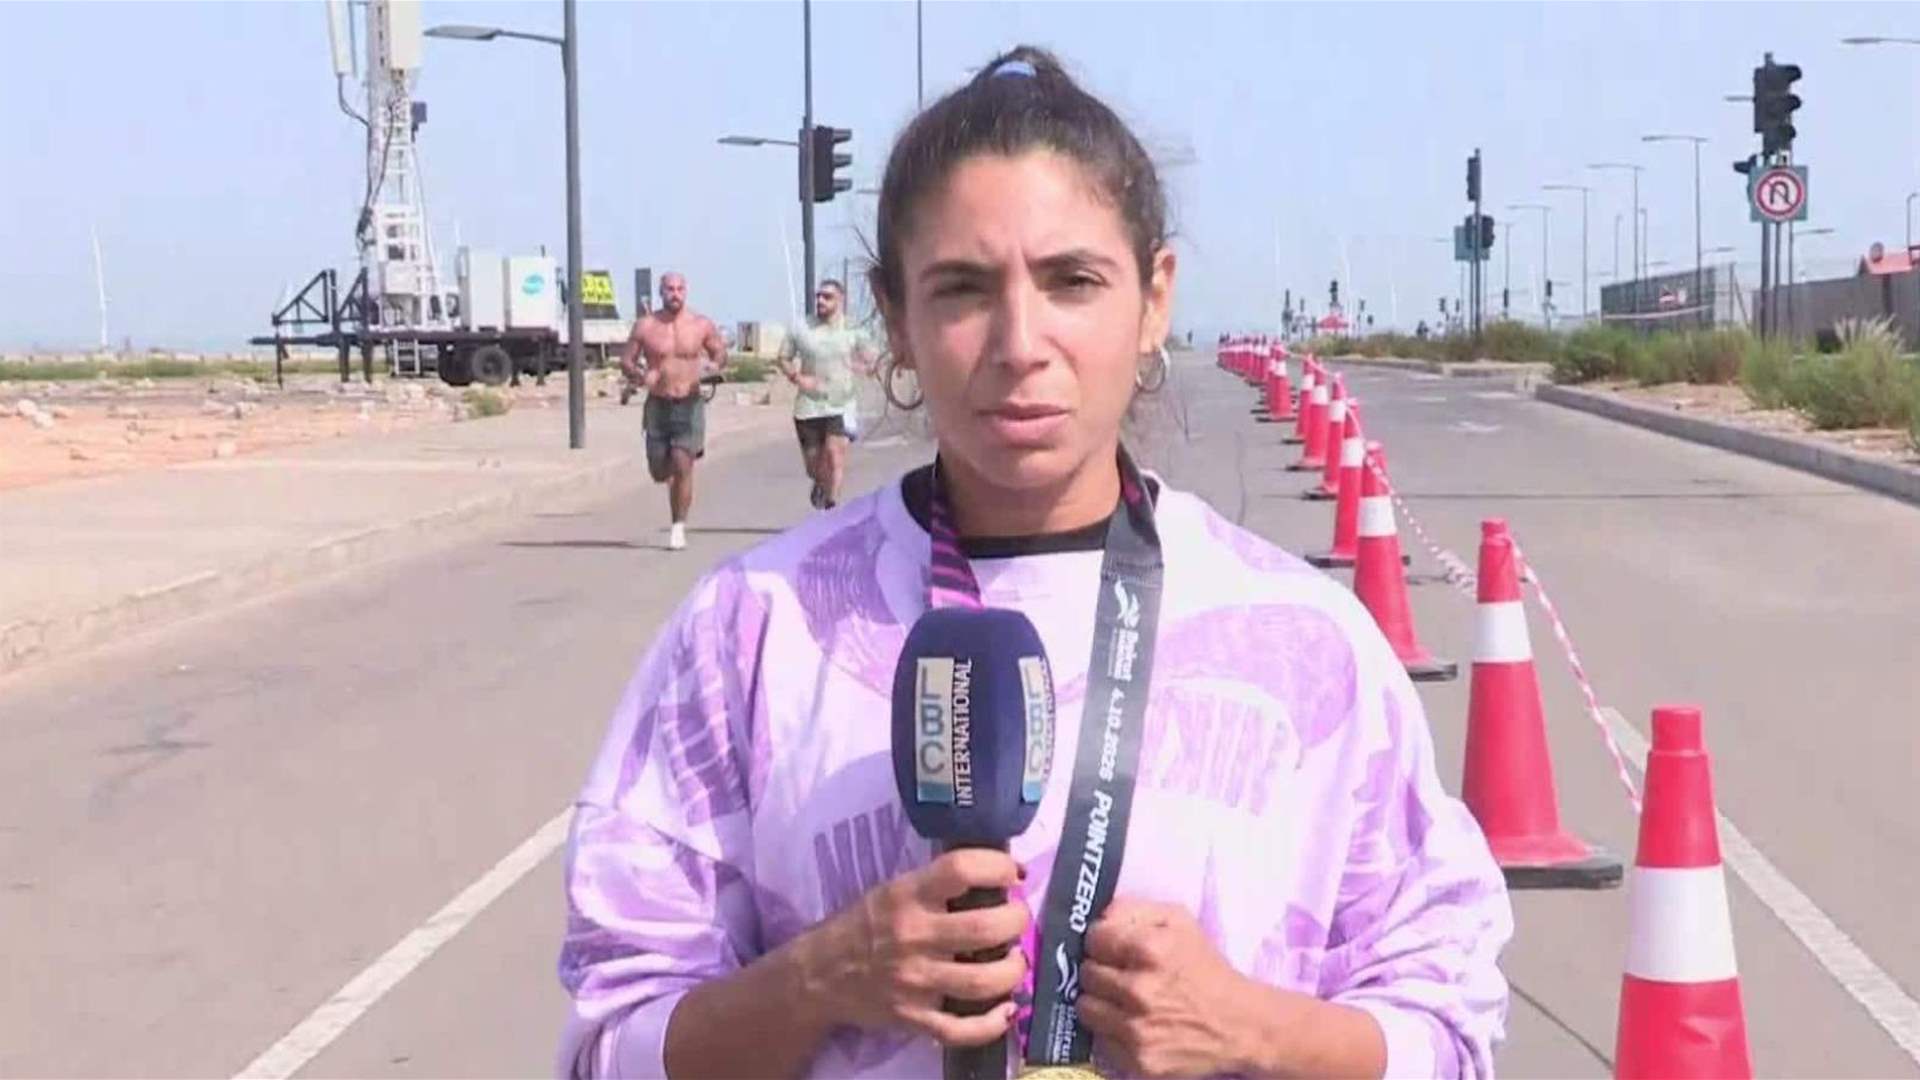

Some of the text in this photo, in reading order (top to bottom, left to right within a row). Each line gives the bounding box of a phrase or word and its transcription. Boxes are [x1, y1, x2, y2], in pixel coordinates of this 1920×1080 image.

[920, 665, 946, 775] LBC
[952, 657, 974, 806] INTERNATIONAL
[1026, 663, 1044, 774] LBC
[1069, 789, 1113, 932] POINTZERO
